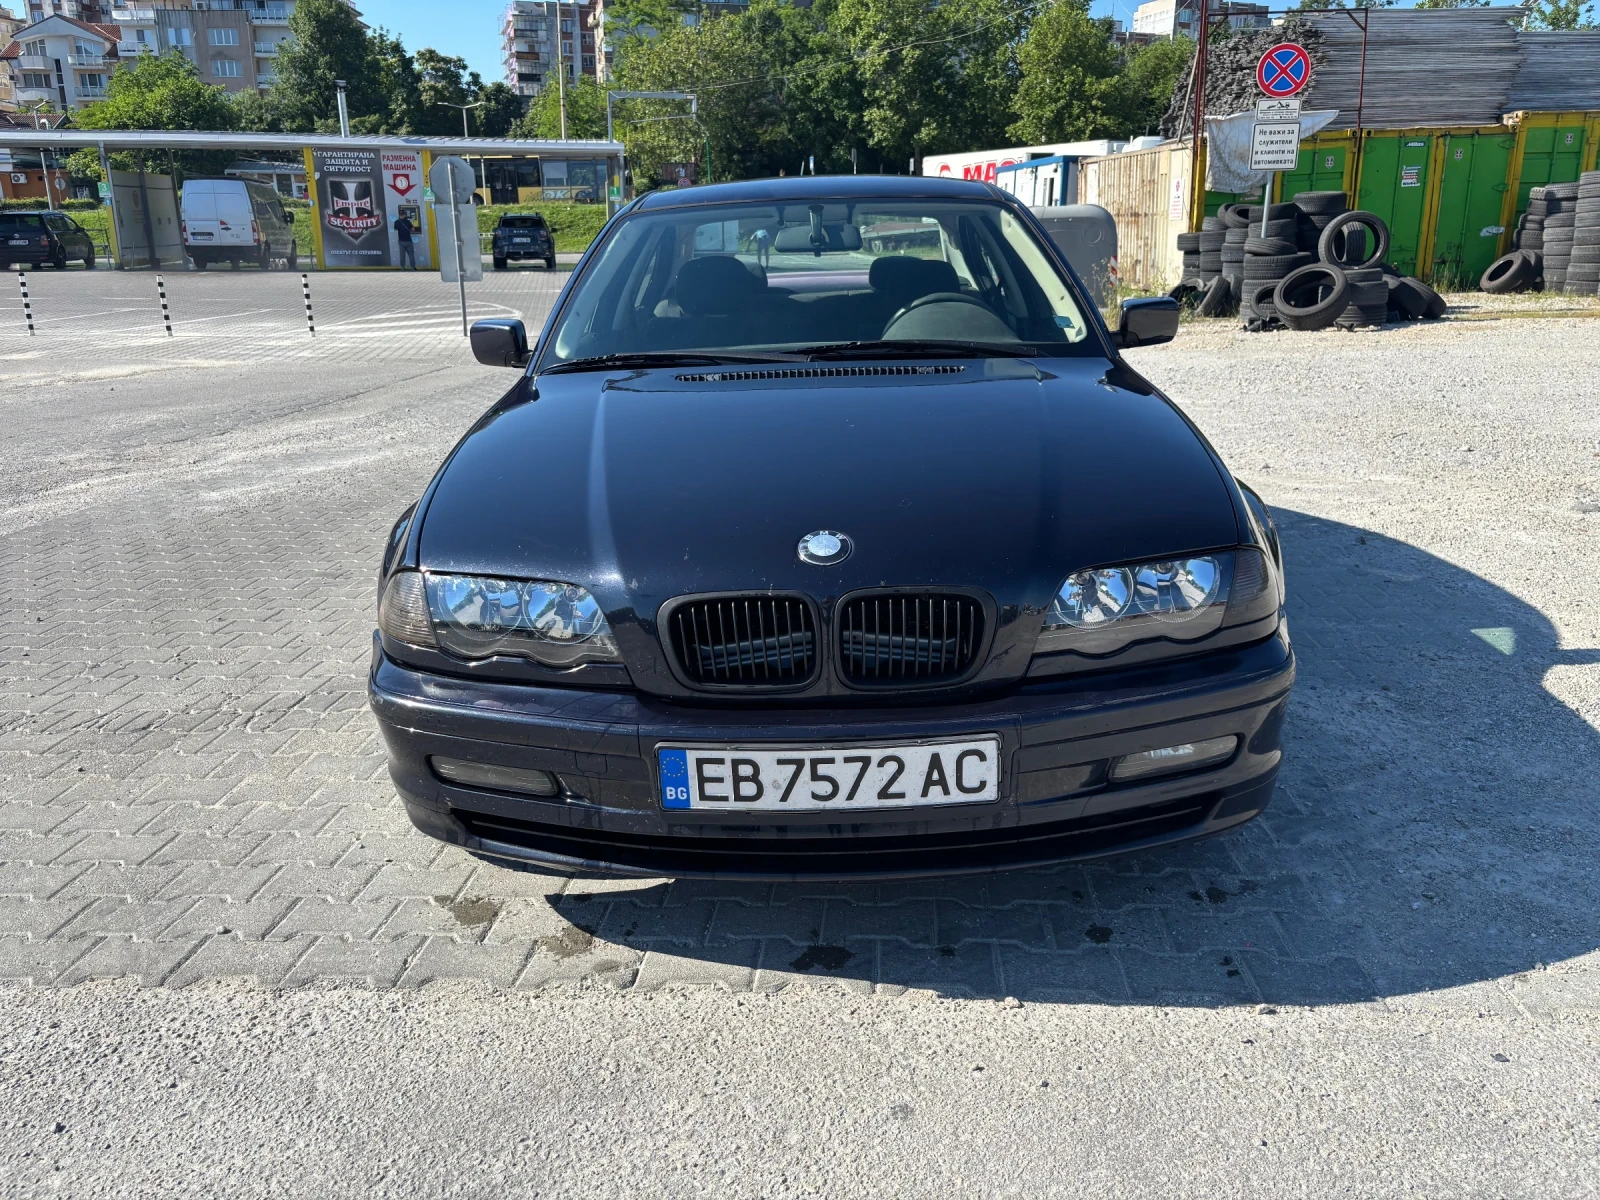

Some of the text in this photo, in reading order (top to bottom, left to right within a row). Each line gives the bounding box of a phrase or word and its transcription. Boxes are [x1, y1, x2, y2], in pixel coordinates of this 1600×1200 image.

[317, 151, 375, 159] ГАРАНТИРАНА
[382, 154, 417, 163] РАЗМЕННА
[325, 158, 360, 166] ЗАЩИТА
[383, 163, 417, 171] МАШИНА
[101, 183, 108, 192] 3
[426, 187, 432, 196] 2
[335, 200, 370, 214] Empire
[330, 217, 378, 228] SECURITY
[695, 748, 988, 803] EB 7572 AC
[666, 786, 688, 801] BG
